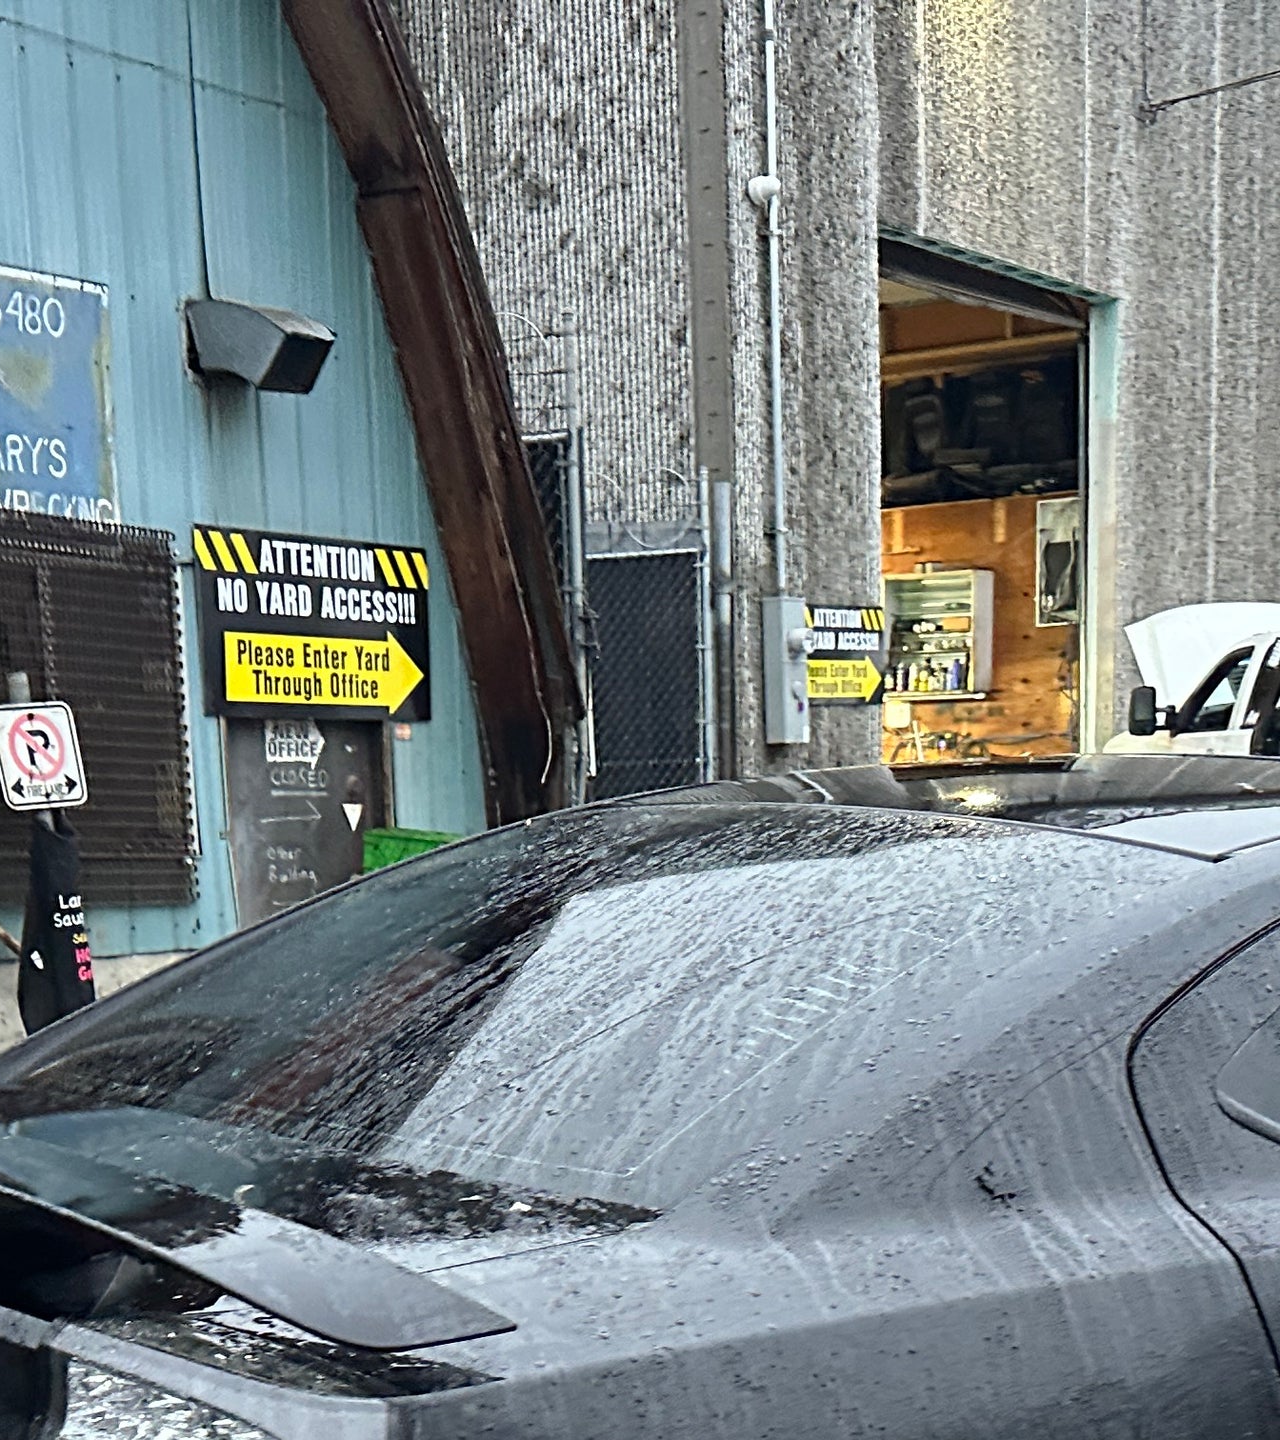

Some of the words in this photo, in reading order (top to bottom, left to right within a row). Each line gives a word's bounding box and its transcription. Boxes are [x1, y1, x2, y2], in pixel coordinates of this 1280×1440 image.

[259, 538, 376, 583] ATTENTION
[216, 577, 249, 614] NO
[255, 579, 313, 617] YARD
[320, 586, 417, 625] ACCESS!!!
[814, 608, 862, 628] ATTENTION
[237, 639, 295, 668] Please
[303, 642, 348, 670] Enter
[354, 645, 391, 672] Yard
[252, 669, 323, 701] Through
[330, 672, 379, 699] Office
[268, 738, 319, 757] OFFICE
